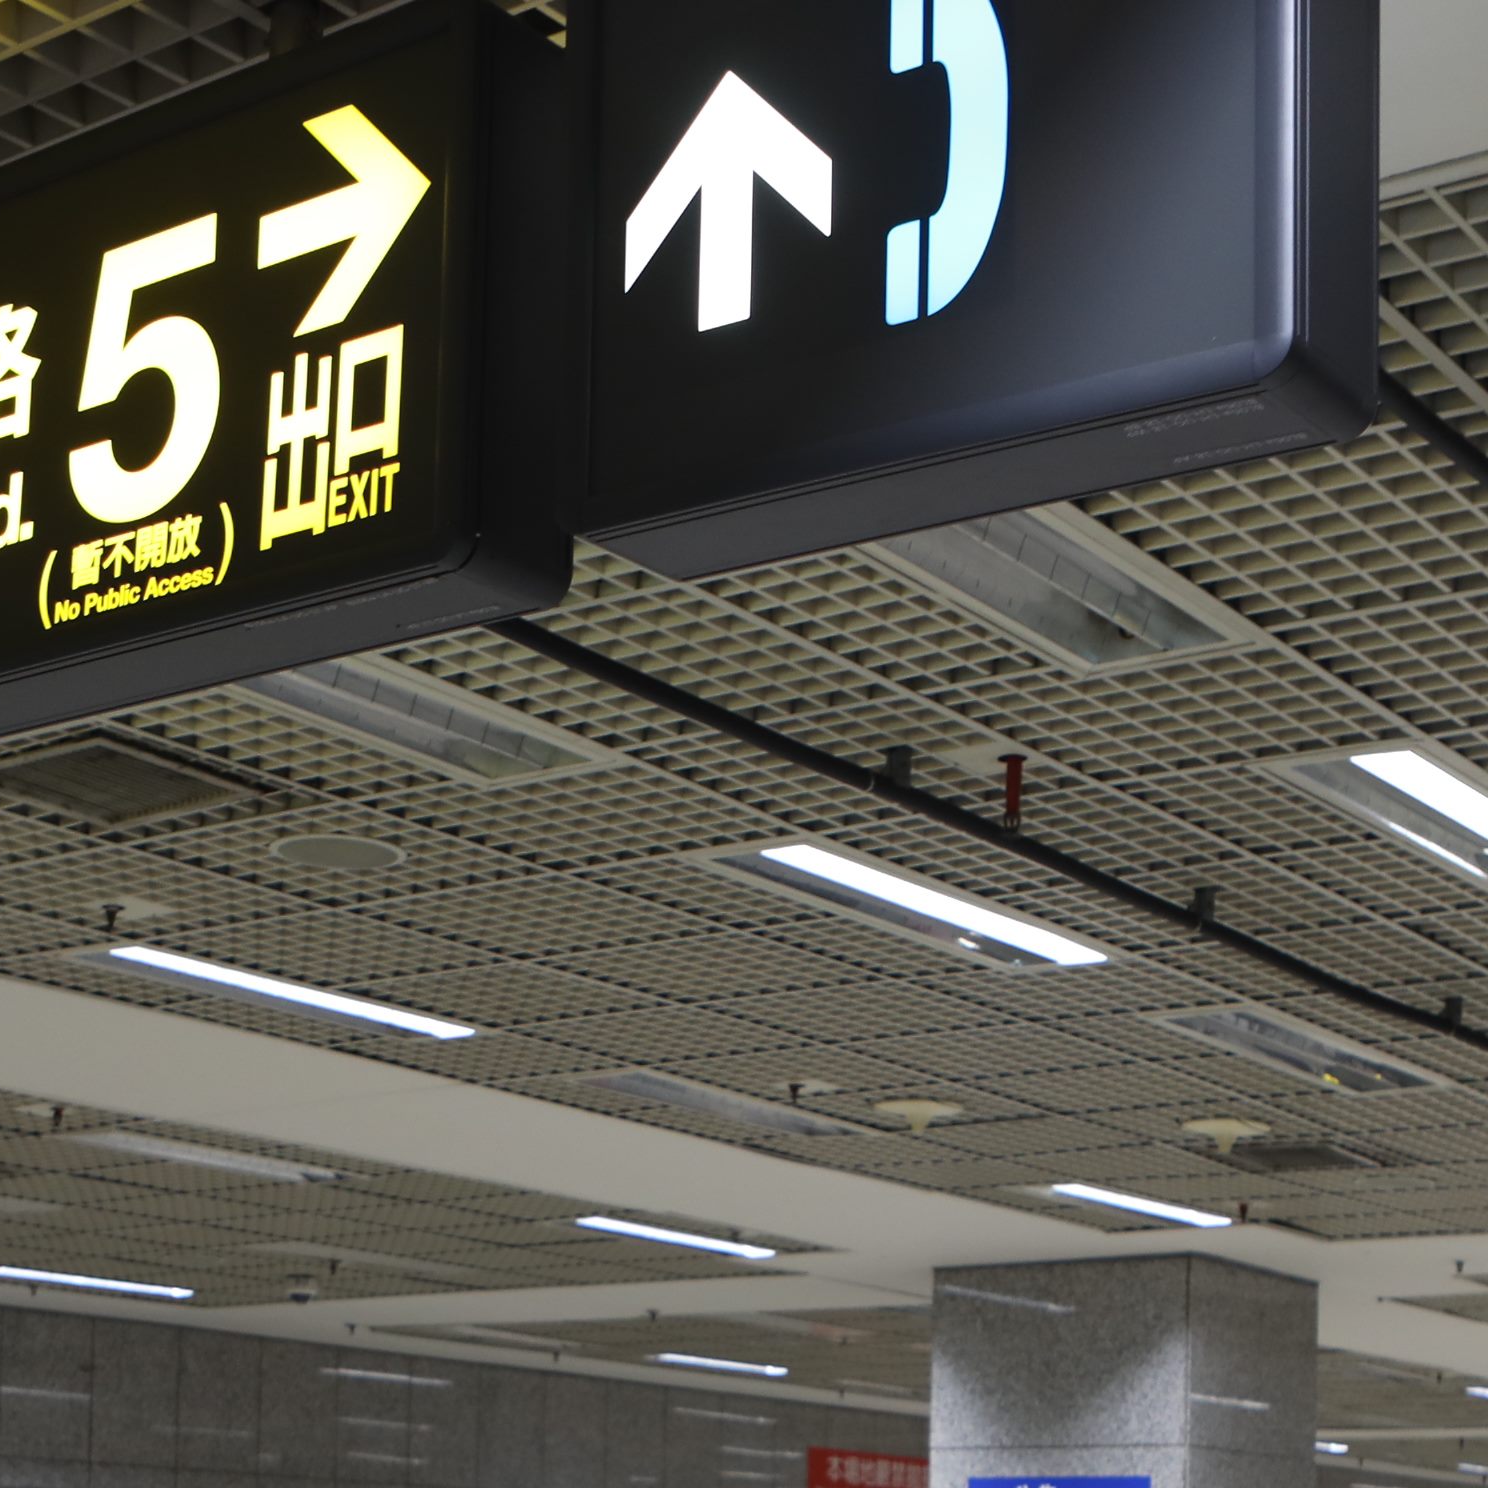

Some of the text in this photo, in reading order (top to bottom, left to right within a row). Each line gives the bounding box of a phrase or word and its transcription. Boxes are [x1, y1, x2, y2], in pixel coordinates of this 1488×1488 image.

[68, 212, 221, 525] 5
[259, 324, 404, 551] 出口
[327, 462, 401, 528] EXIT
[53, 566, 215, 624] No Public Access
